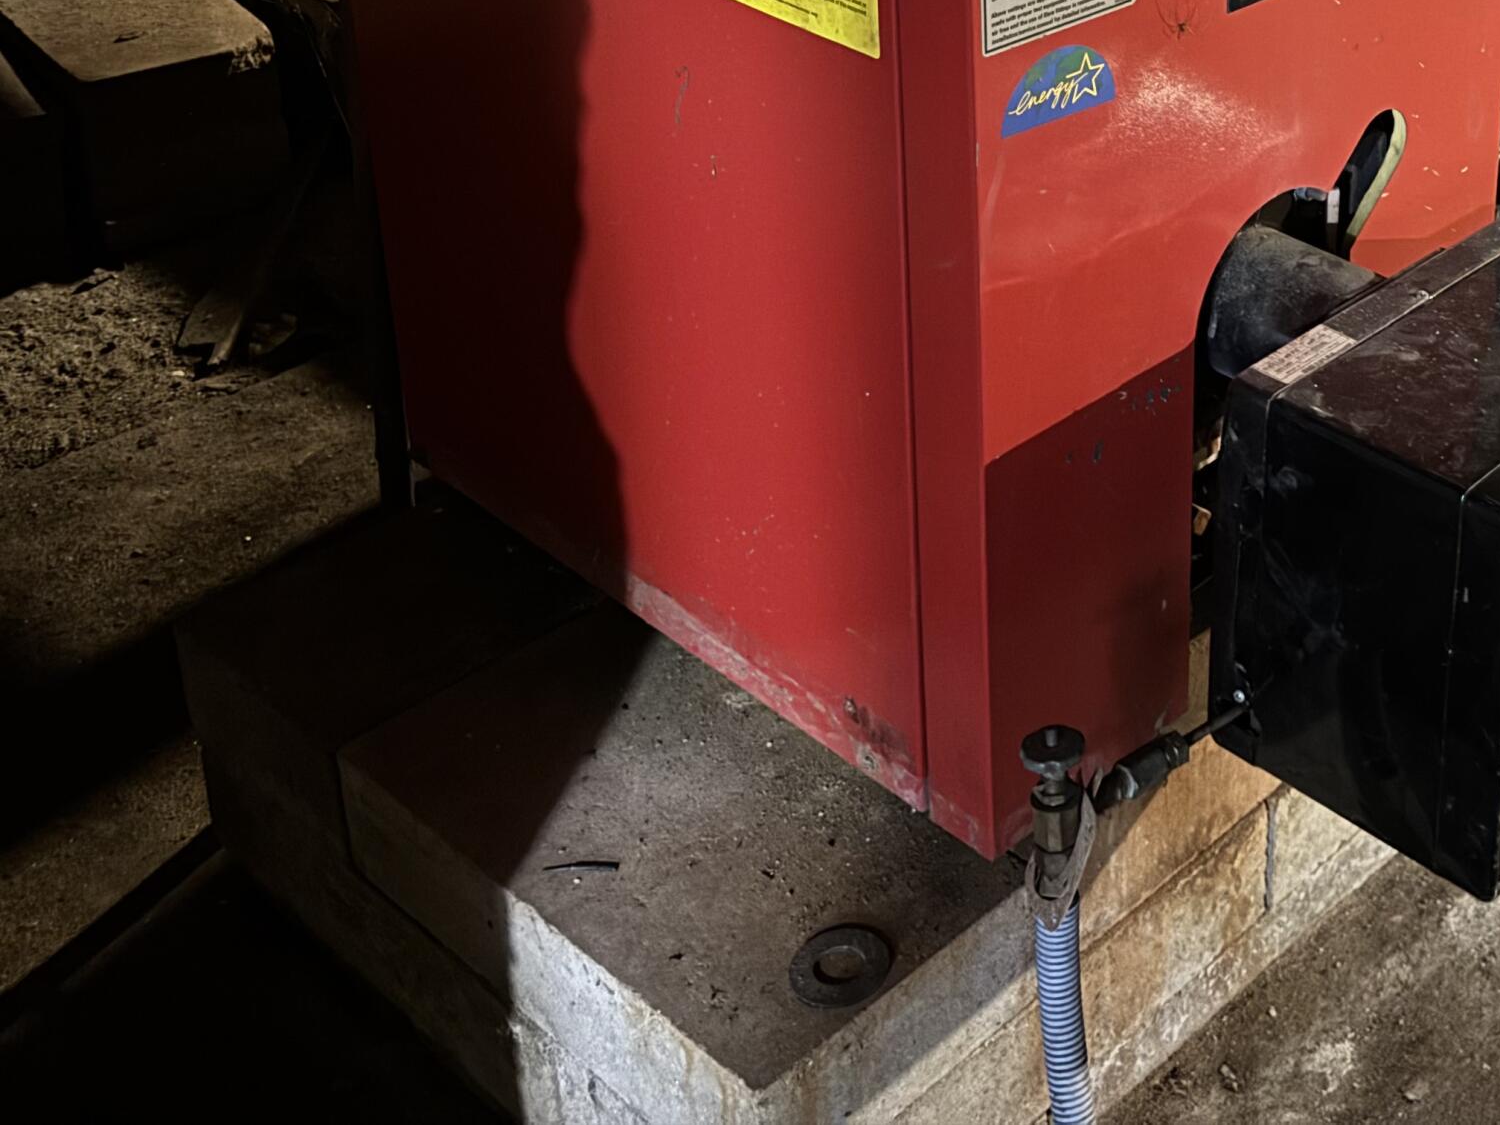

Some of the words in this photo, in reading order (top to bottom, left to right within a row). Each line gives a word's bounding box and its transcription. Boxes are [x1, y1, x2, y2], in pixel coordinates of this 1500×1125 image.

[991, 9, 1006, 19] Above
[1017, 9, 1032, 20] proper
[1008, 72, 1088, 115] energy
